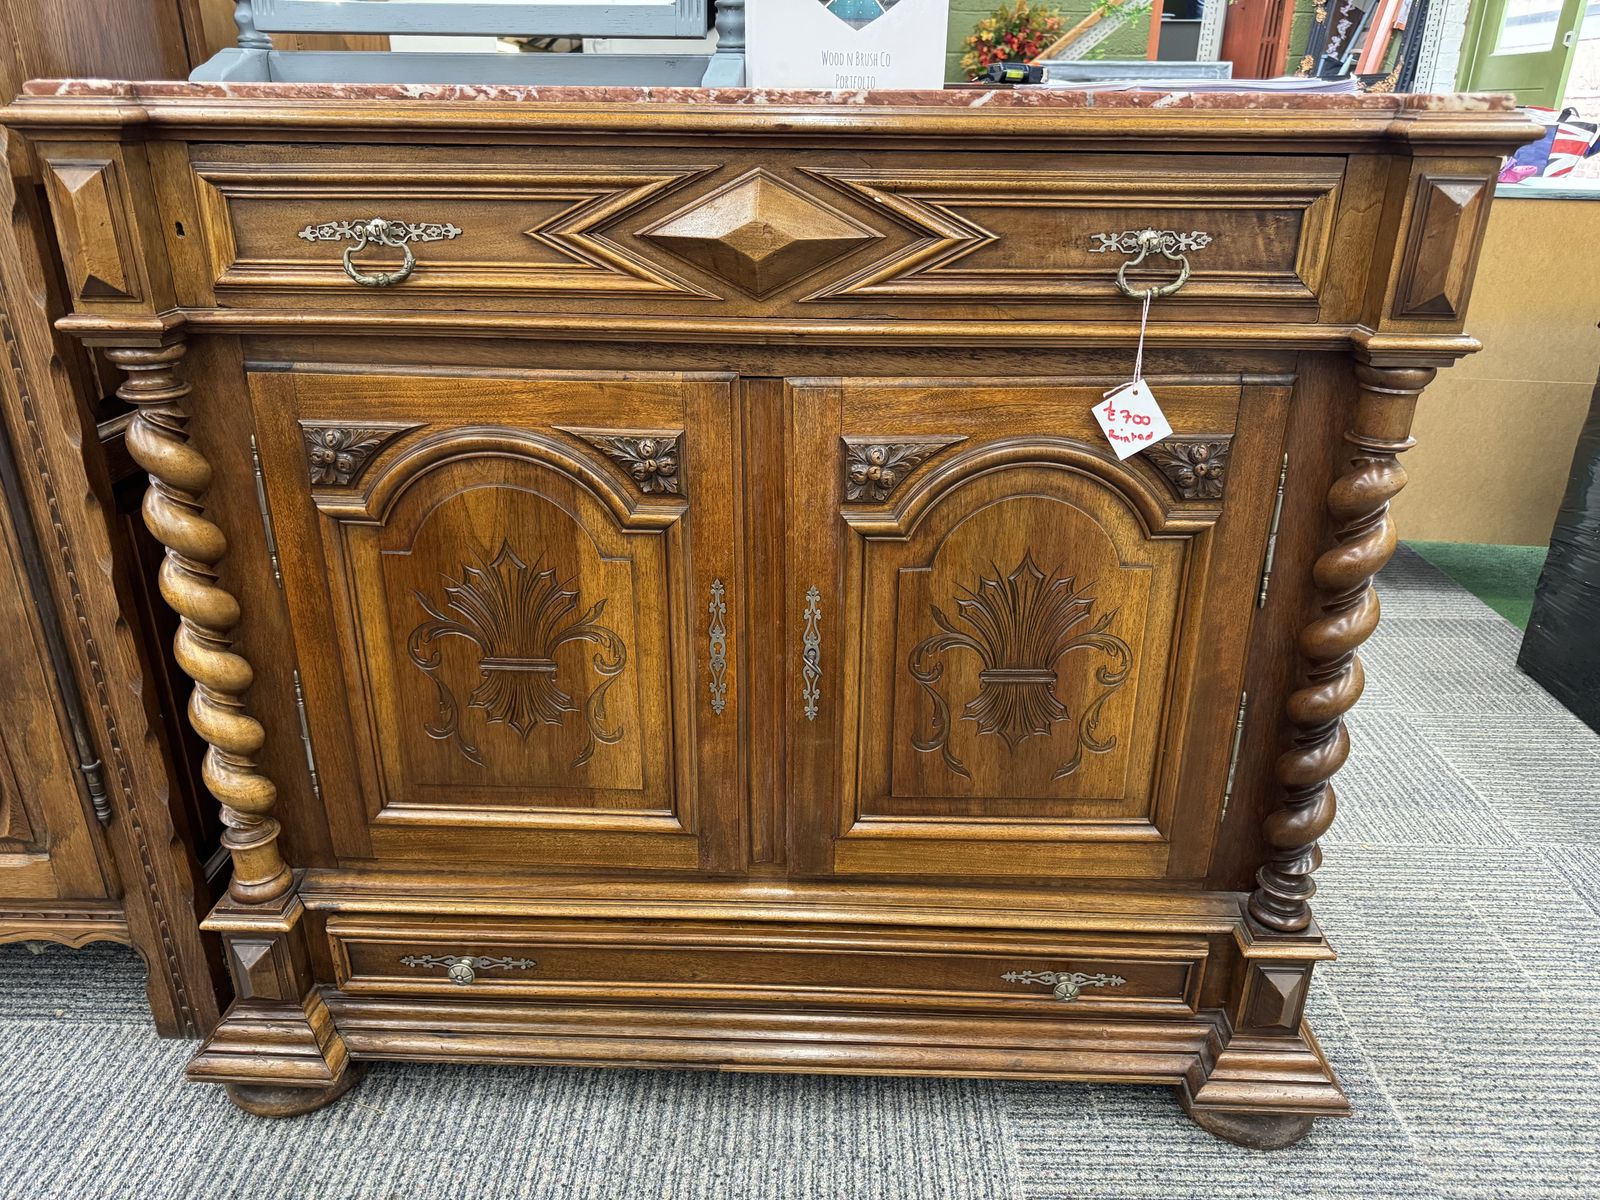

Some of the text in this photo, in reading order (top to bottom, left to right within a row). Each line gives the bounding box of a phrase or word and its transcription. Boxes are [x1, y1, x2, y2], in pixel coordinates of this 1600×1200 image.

[821, 49, 891, 67] WOOD N BRUSH CO
[835, 73, 876, 89] PORTFOLIO
